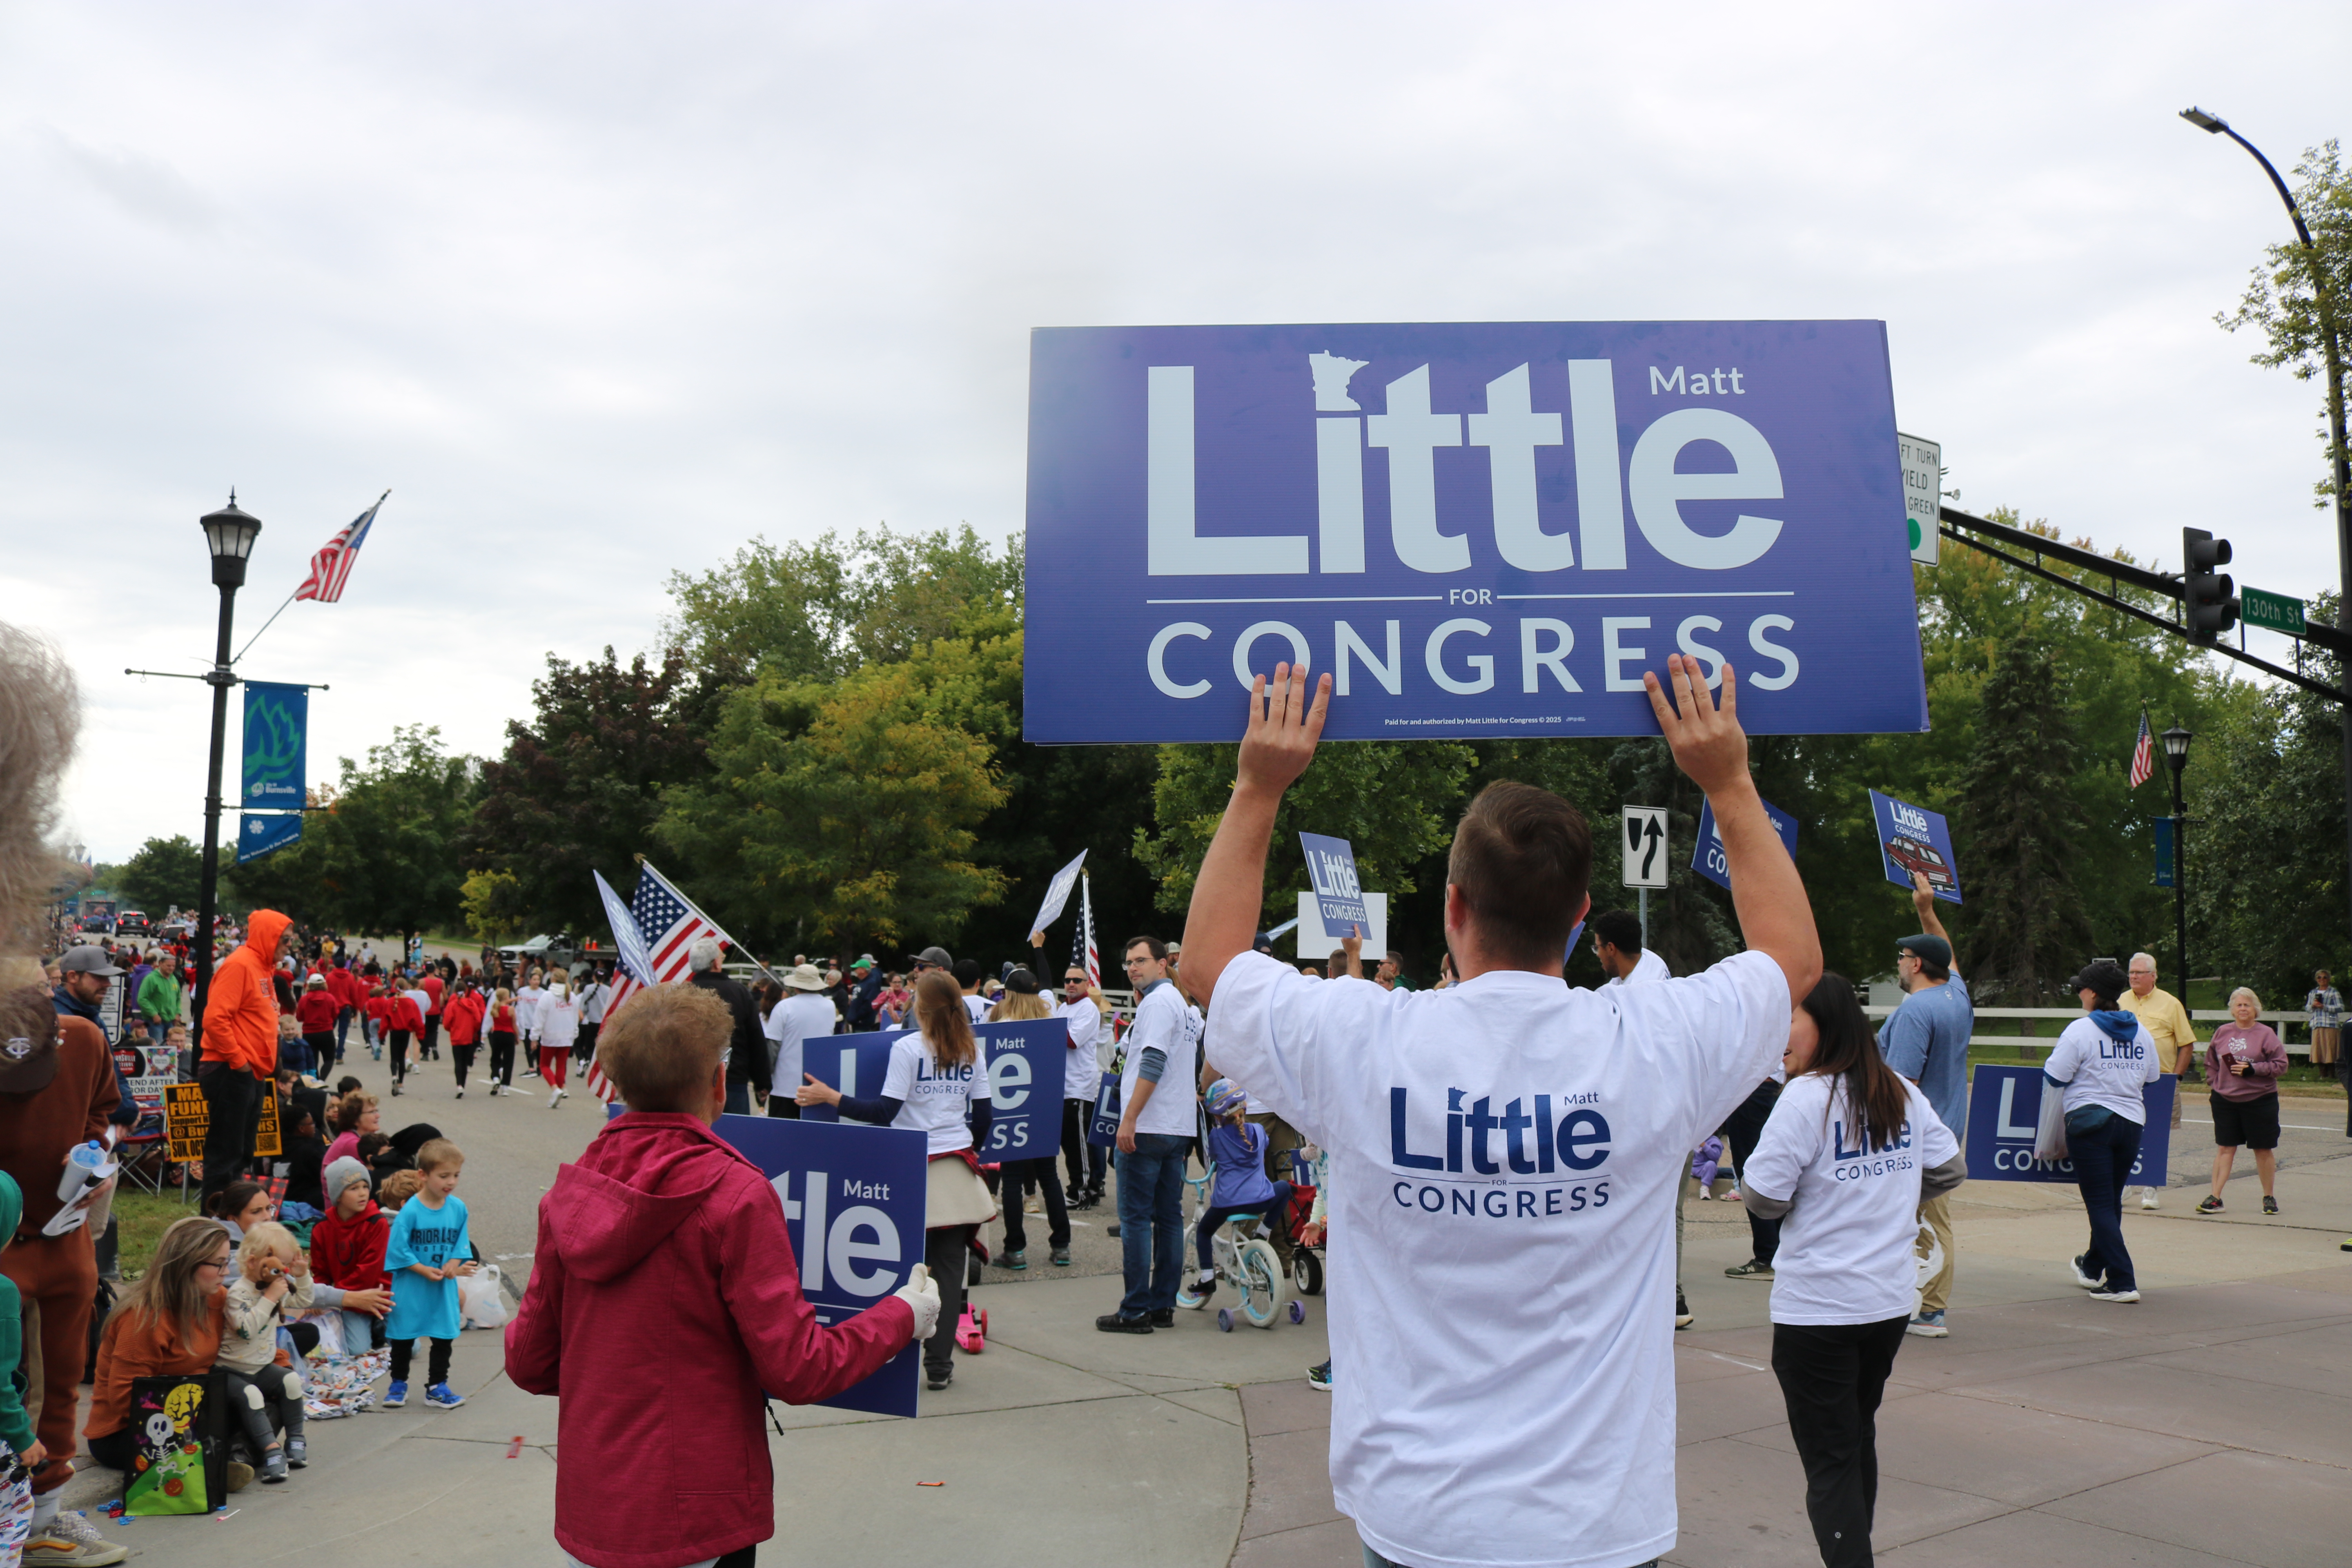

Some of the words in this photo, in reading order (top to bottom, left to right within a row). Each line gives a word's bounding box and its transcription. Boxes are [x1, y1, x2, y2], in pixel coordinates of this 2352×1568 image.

[1649, 365, 1744, 396] Matt
[1148, 349, 1784, 575] Little
[1899, 444, 1911, 459] FT
[1916, 448, 1937, 466] TURN
[1908, 496, 1935, 515] GREEN
[1449, 588, 1493, 606] FOR
[2246, 597, 2281, 621] 130th
[2287, 606, 2300, 625] St
[1147, 613, 1800, 699] CONGRESS
[1771, 817, 1783, 831] Matt
[1889, 801, 1928, 833] Little
[1895, 824, 1931, 844] CONGRESS
[1308, 849, 1360, 900] Little
[1323, 903, 1366, 923] CONGRESS
[996, 1037, 1025, 1050] Matt
[2102, 1062, 2144, 1071] CONGRESS
[1564, 1092, 1599, 1106] Matt
[170, 1116, 201, 1126] Support
[1391, 1086, 1611, 1175] Little
[844, 1179, 890, 1201] Matt
[1394, 1182, 1610, 1218] CONGRESS
